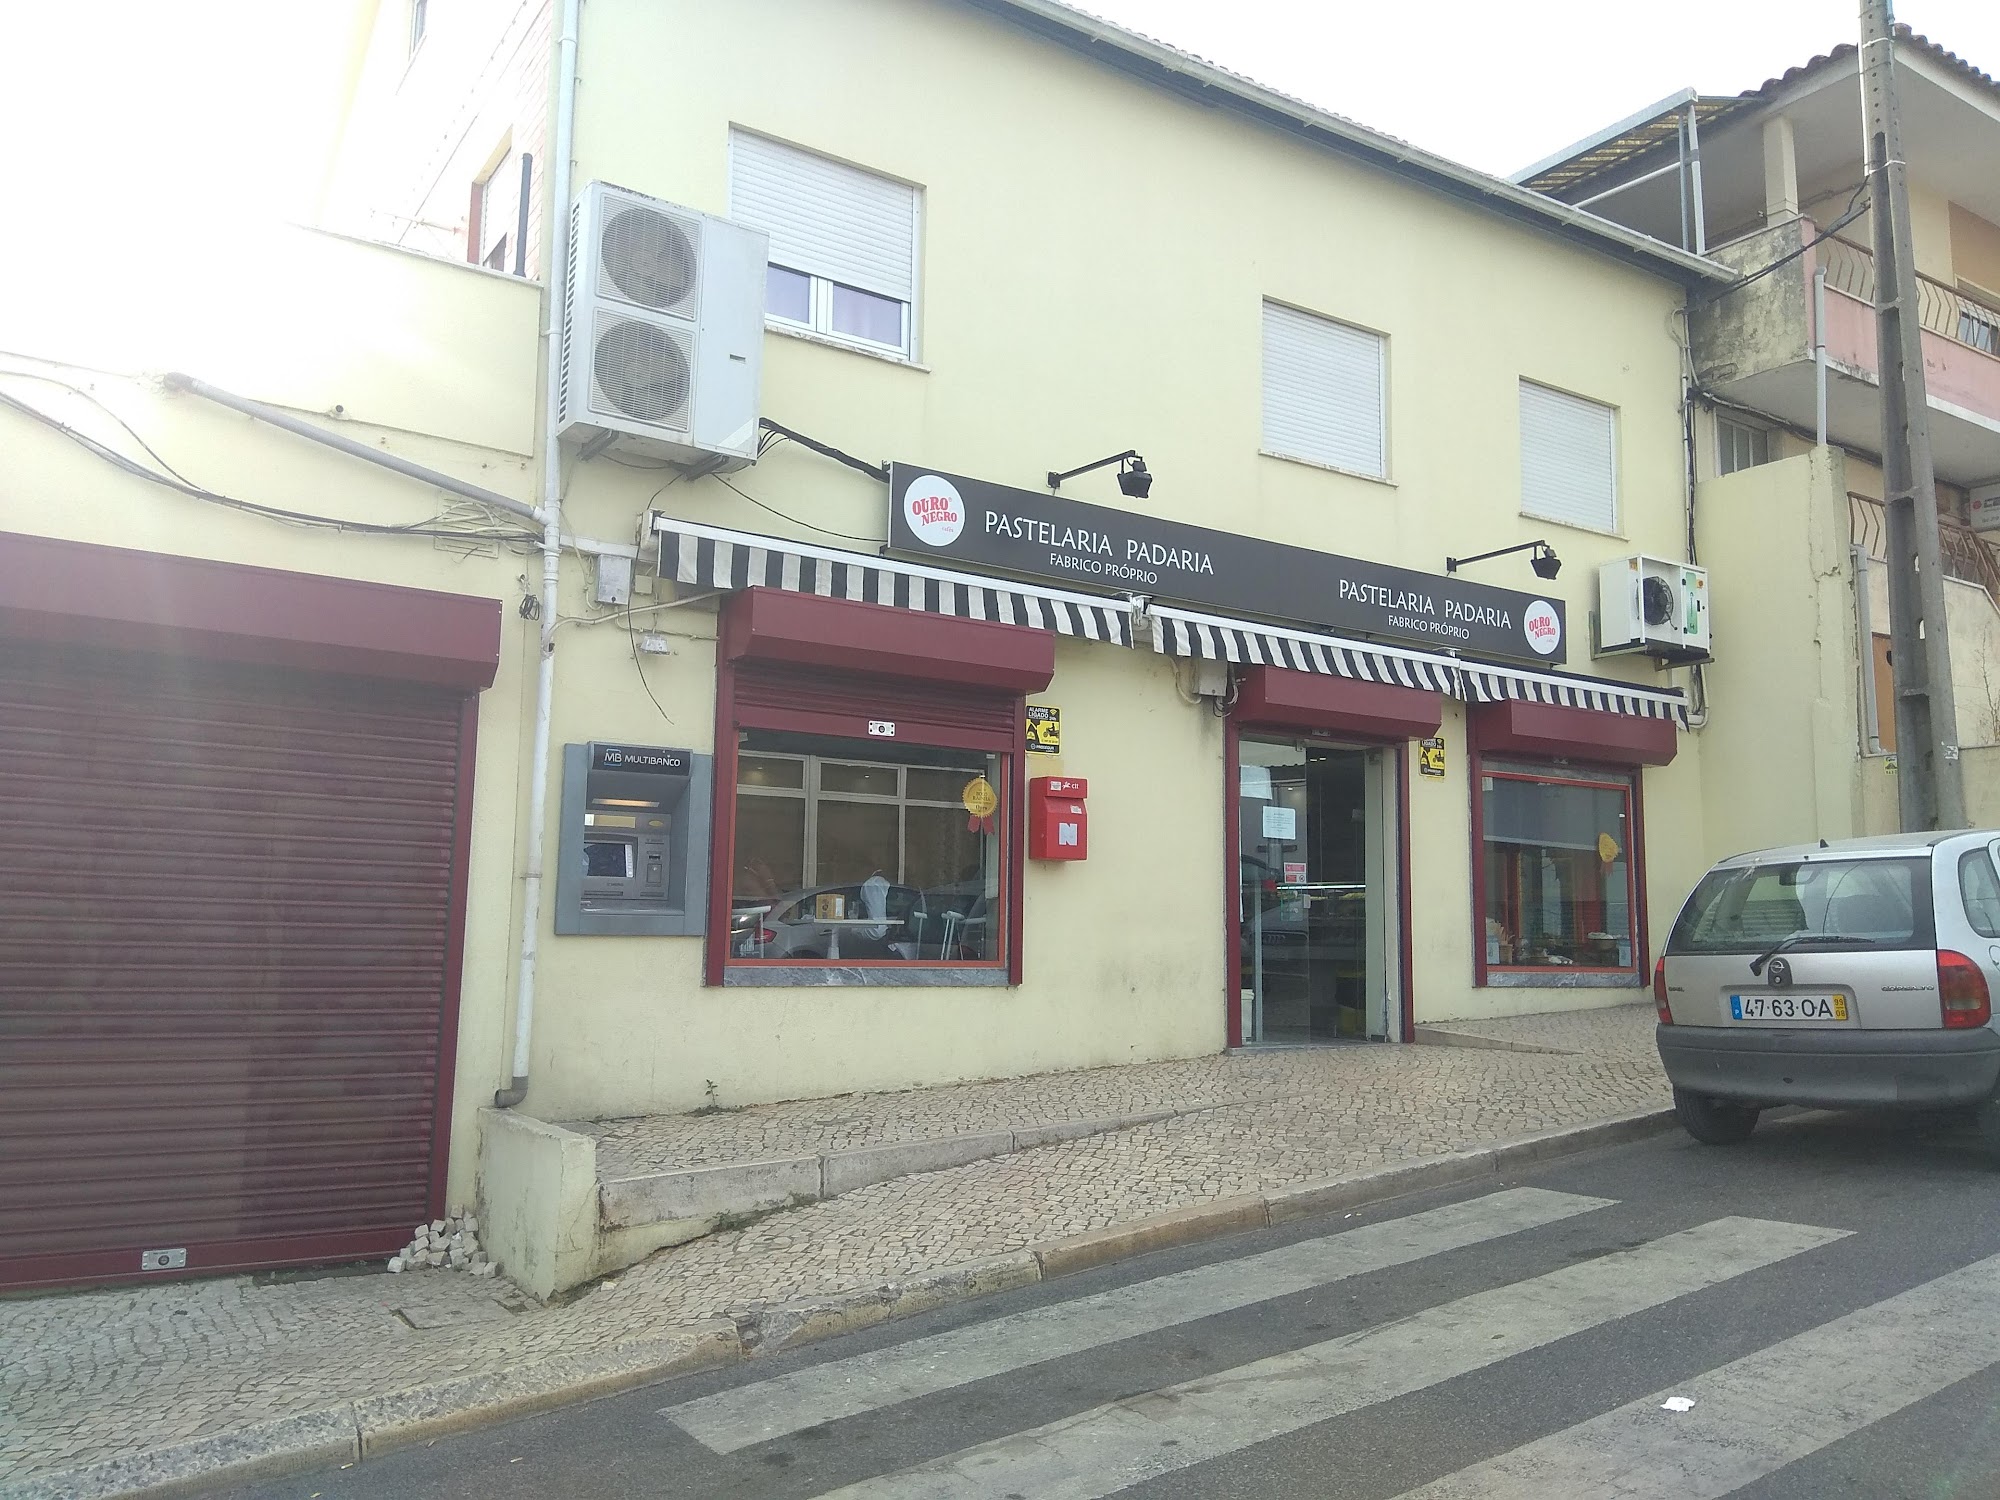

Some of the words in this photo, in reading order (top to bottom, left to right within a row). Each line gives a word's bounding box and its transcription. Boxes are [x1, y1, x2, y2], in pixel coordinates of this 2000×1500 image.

[912, 496, 949, 515] OURO
[921, 511, 958, 526] NEGRO
[985, 510, 1113, 557] PASTELARIA
[1126, 539, 1214, 576] PADARIA
[1049, 553, 1102, 574] FABRICO
[1105, 563, 1158, 585] PRÓPRIO
[1339, 579, 1435, 616] PASTELARIA
[1444, 600, 1512, 630] PADARIA
[1388, 615, 1428, 632] FABRICO
[1430, 621, 1470, 640] PRÓPRIO
[1528, 616, 1551, 632] OURO
[1534, 627, 1556, 640] NEGRO
[604, 750, 622, 763] MB
[624, 754, 681, 767] MULTIBANCO
